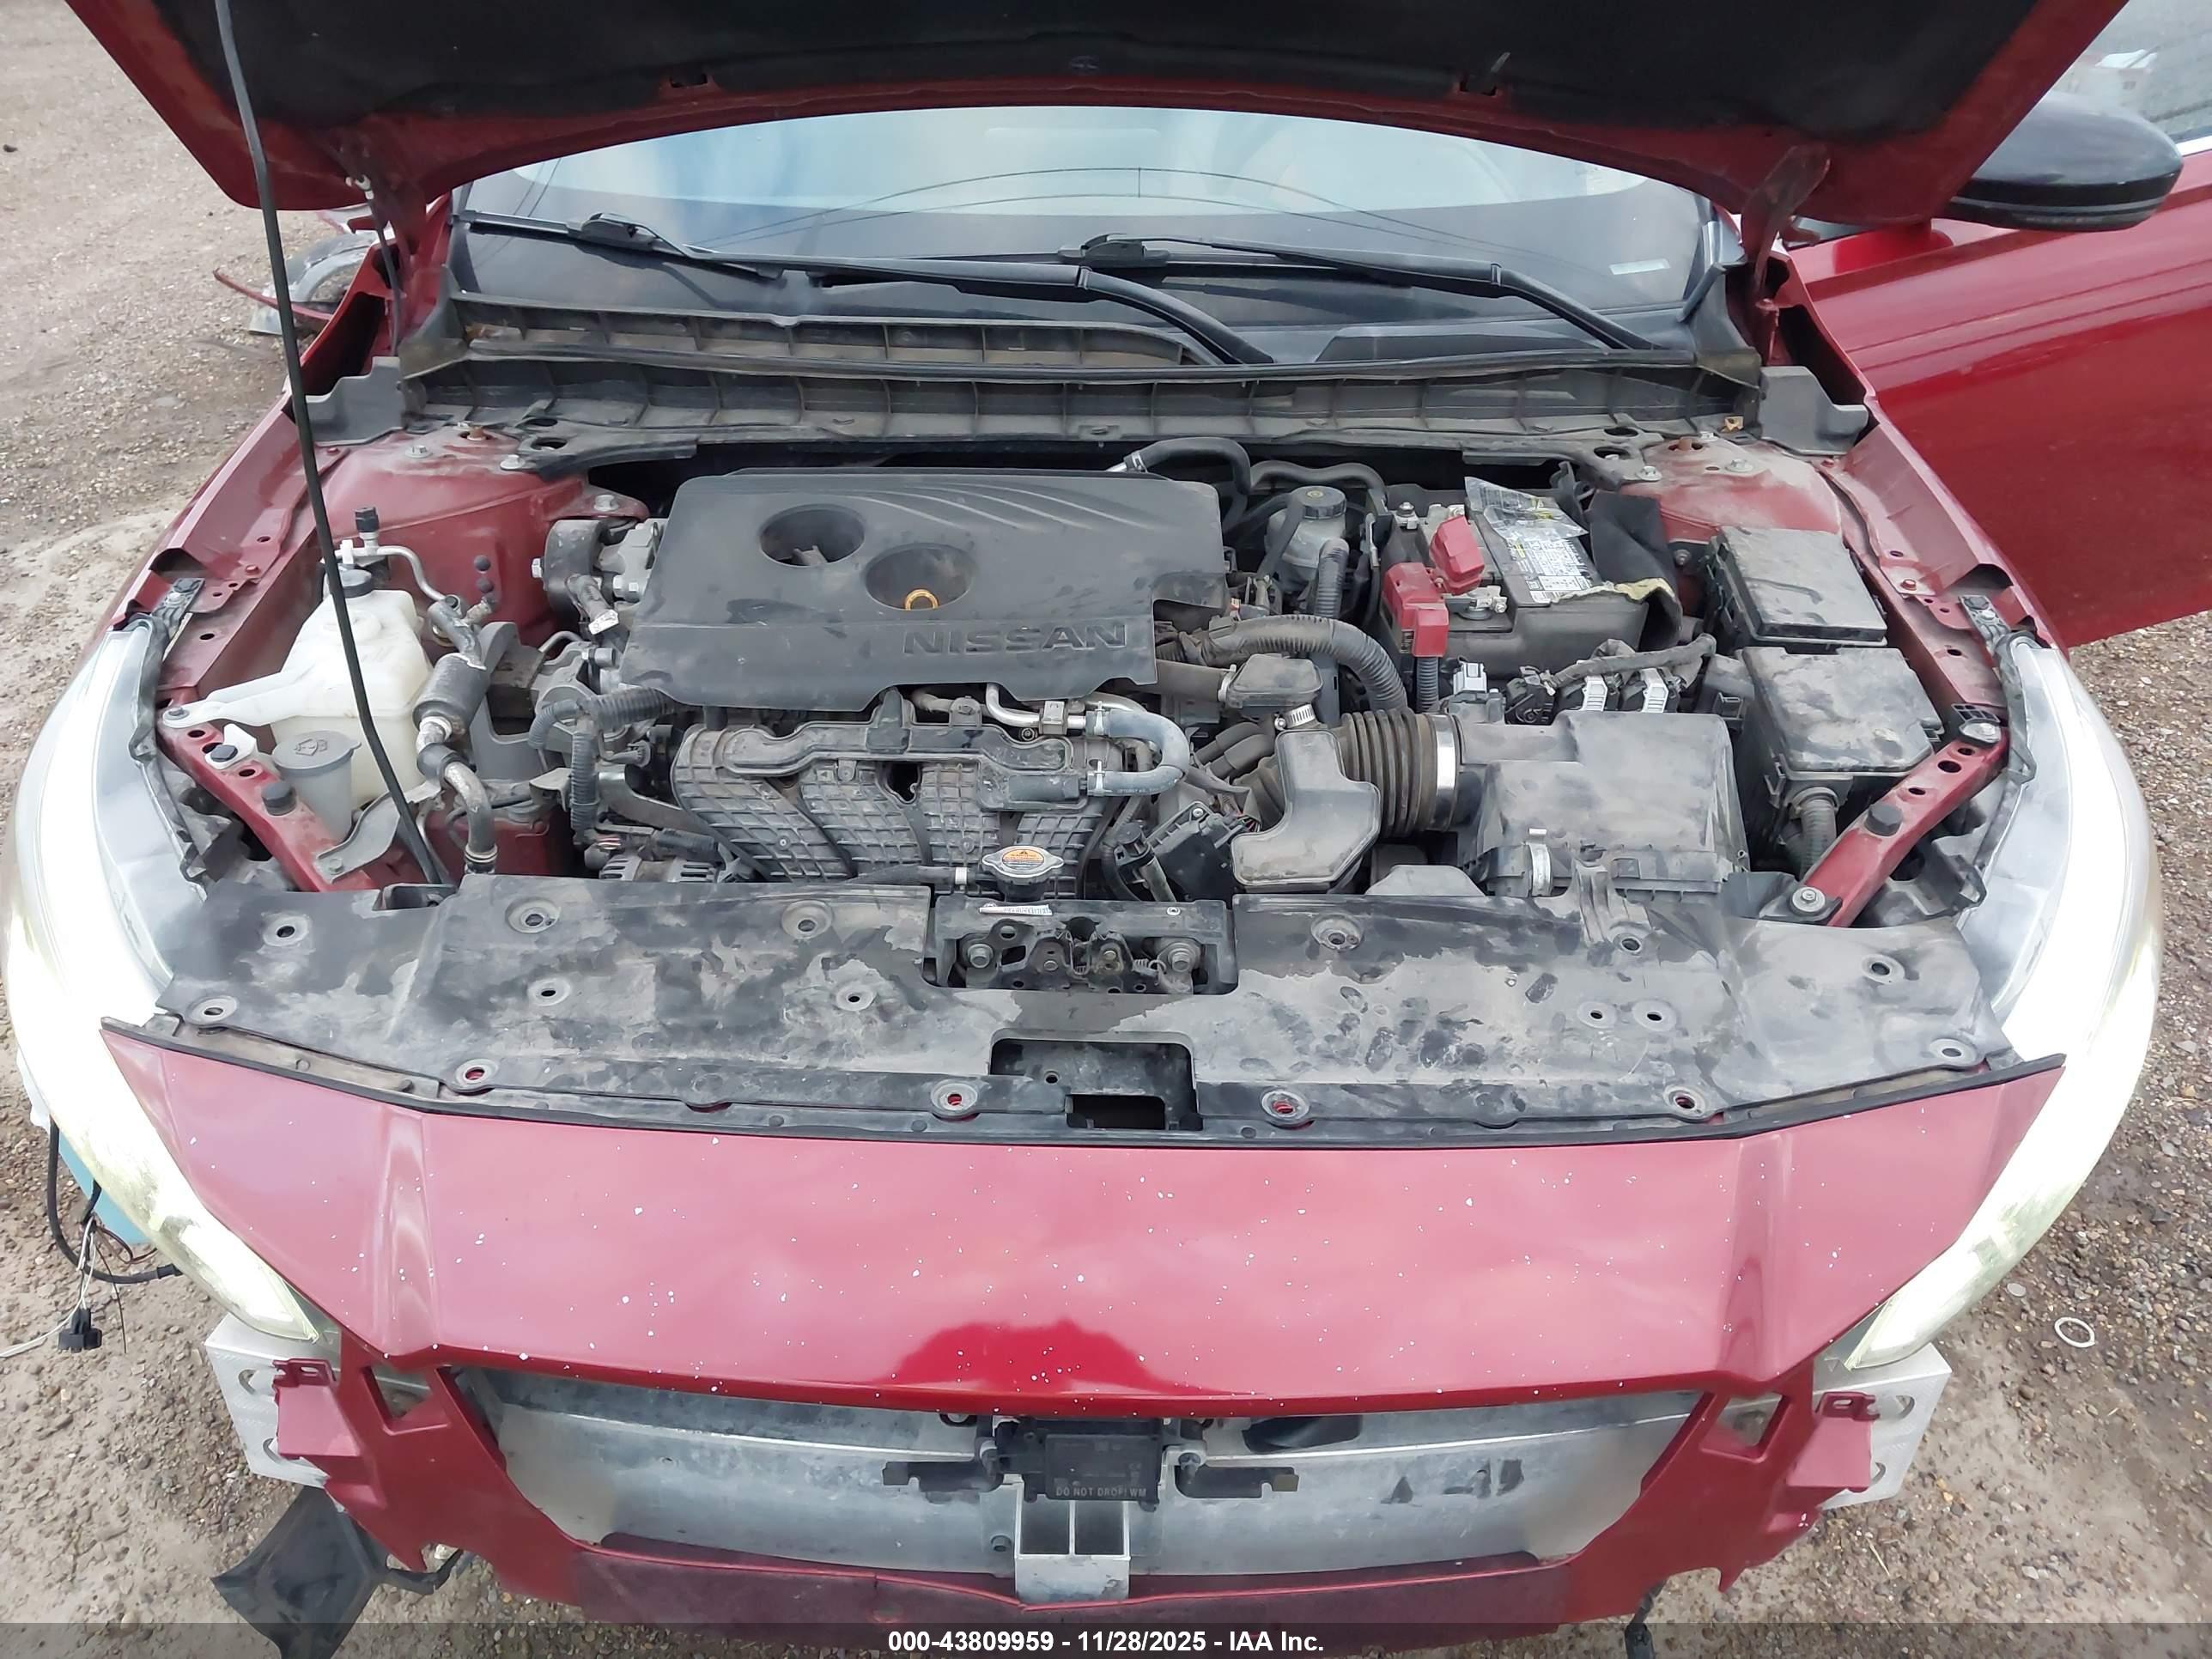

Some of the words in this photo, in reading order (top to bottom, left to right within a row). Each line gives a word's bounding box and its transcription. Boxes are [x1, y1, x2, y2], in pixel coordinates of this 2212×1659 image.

[902, 624, 1127, 655] NISSAN
[1055, 1486, 1070, 1497] DO
[1074, 1486, 1093, 1497] NOT
